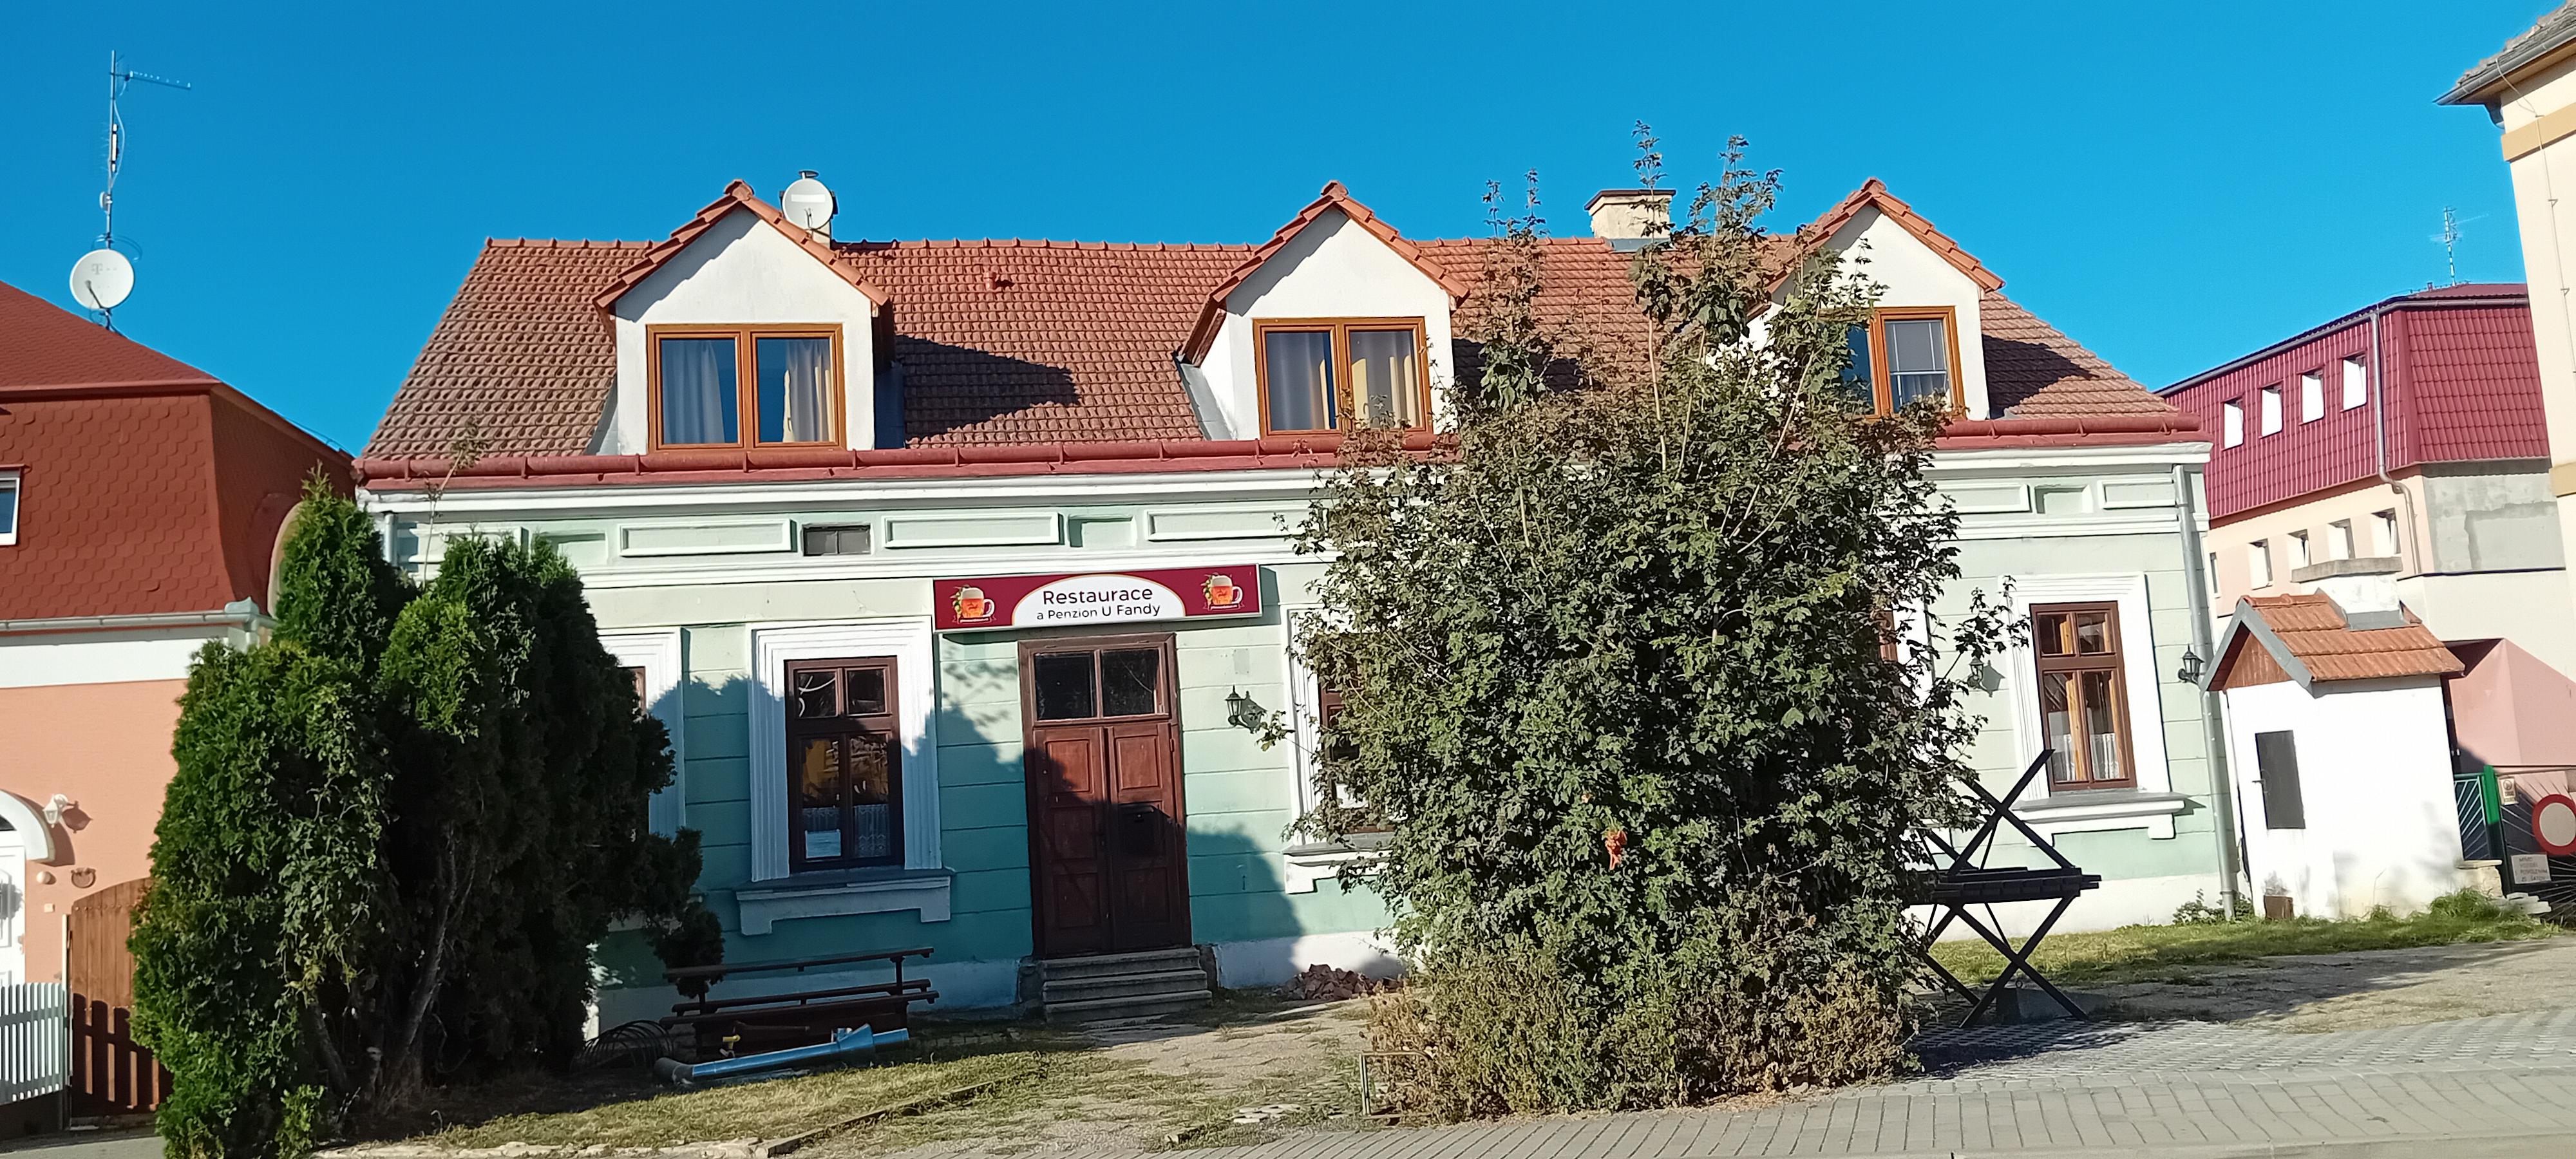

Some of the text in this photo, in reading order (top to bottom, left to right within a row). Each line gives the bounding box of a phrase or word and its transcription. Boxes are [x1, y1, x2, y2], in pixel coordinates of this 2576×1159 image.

[1043, 589, 1153, 605] Restaurace
[1048, 608, 1098, 619] Penzion
[1102, 605, 1112, 617] U
[1117, 603, 1160, 617] Fandy
